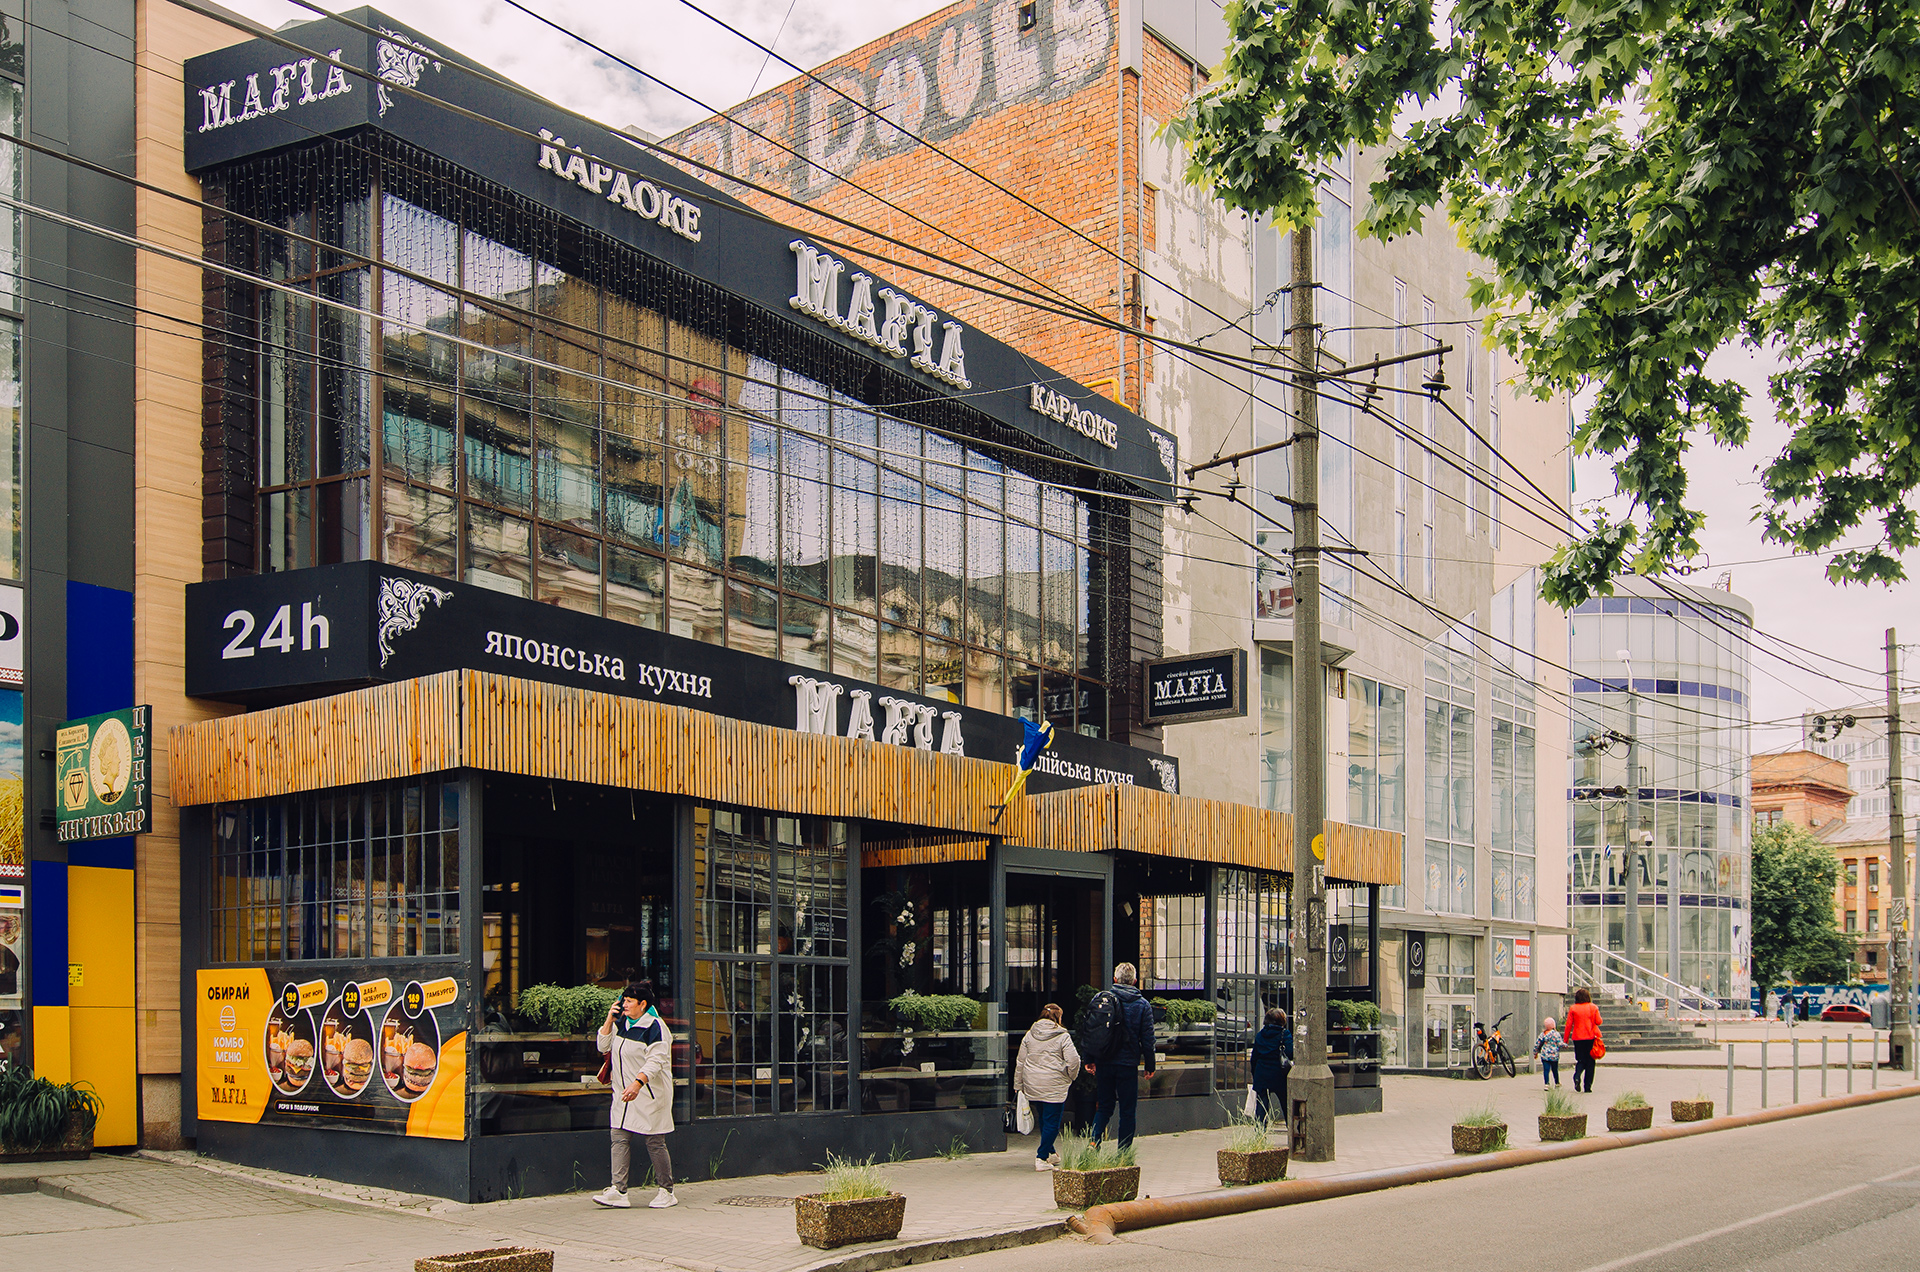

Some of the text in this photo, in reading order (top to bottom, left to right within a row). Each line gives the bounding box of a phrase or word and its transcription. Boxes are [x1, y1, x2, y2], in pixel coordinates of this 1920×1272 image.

[198, 48, 352, 133] MAFIA
[537, 128, 702, 243] КАРАОКЕ
[789, 238, 972, 390] MAFIA
[1029, 381, 1118, 450] КАРАОКЕ
[221, 601, 331, 660] 24h
[484, 630, 713, 699] японська кухня
[1153, 673, 1228, 700] MAFIA
[788, 674, 966, 757] MAFIA
[1015, 744, 1135, 791] ілійська кухня
[57, 809, 146, 841] АНТИКВАР
[207, 983, 250, 1001] ОБИРАЙ
[285, 991, 297, 1002] 199
[345, 991, 358, 1002] 239
[363, 986, 377, 996] ДАБЛ
[407, 993, 420, 1004] 189
[213, 1036, 245, 1049] КОМБО
[215, 1051, 242, 1063] МЕНЮ
[223, 1074, 236, 1084] ВІД
[211, 1087, 248, 1105] MAFIA
